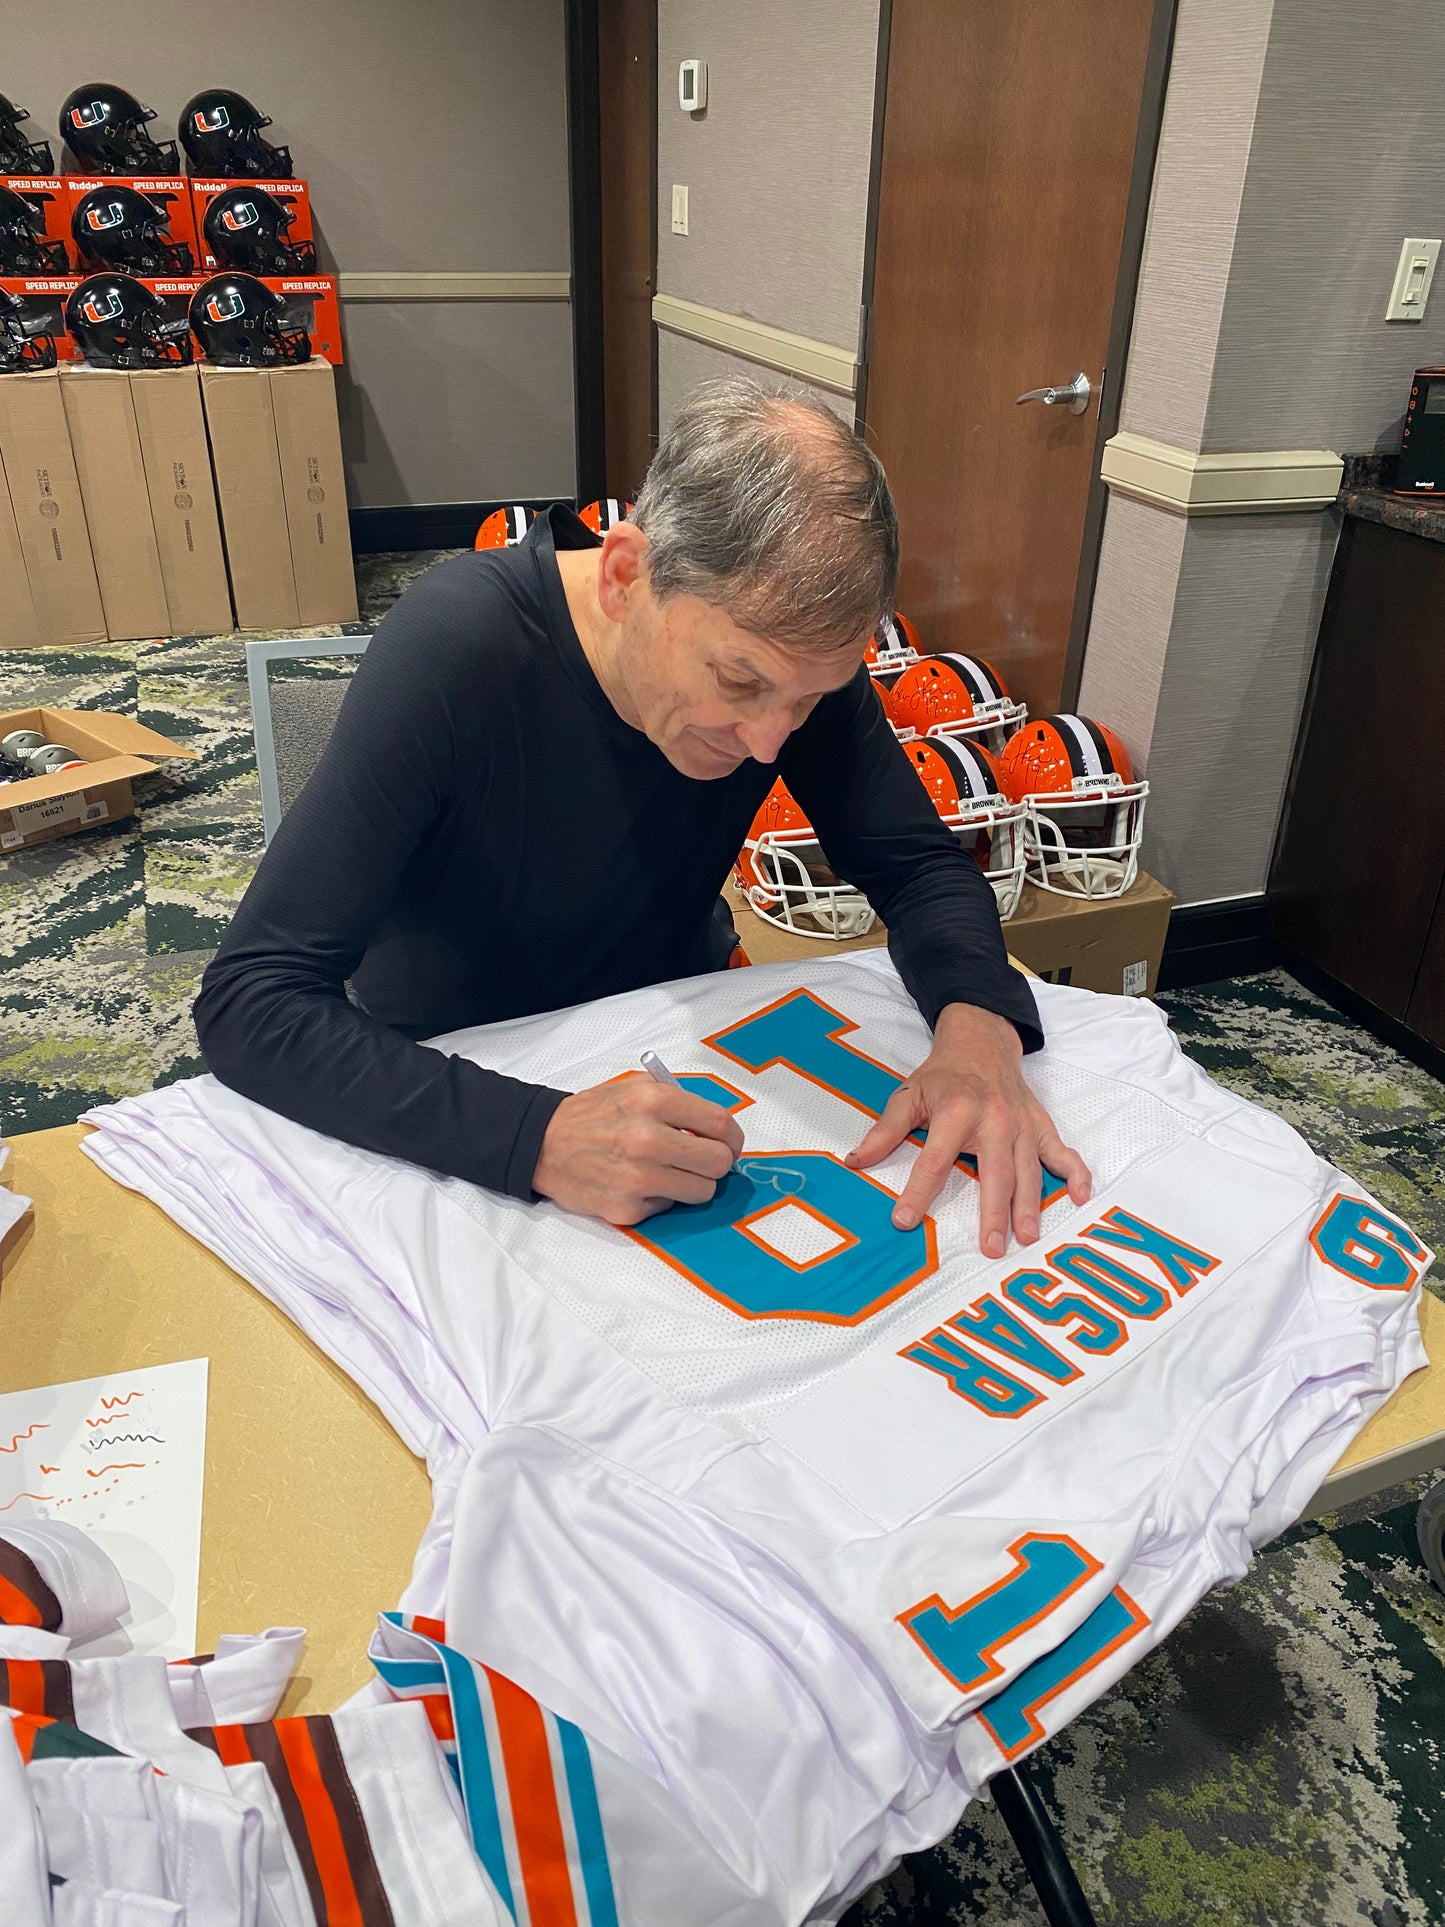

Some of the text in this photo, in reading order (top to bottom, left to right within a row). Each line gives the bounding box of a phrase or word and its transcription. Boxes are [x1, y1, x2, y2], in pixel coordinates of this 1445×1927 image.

[8, 180, 62, 190] SPEED REPLICA
[68, 181, 104, 190] Riddell
[133, 181, 184, 190] SPEED REPLICA
[194, 183, 227, 191] Riddell
[277, 184, 304, 192] REPLICA
[25, 282, 49, 290] SPEED
[154, 283, 201, 291] SPEED REPLI
[282, 281, 331, 290] SPEED REPLICA
[888, 651, 908, 660] BROWNS
[984, 702, 1003, 712] BROWNS
[1084, 778, 1110, 787] BROWNS
[971, 799, 996, 810] BROWNS
[897, 1205, 1221, 1419] KOSAR
